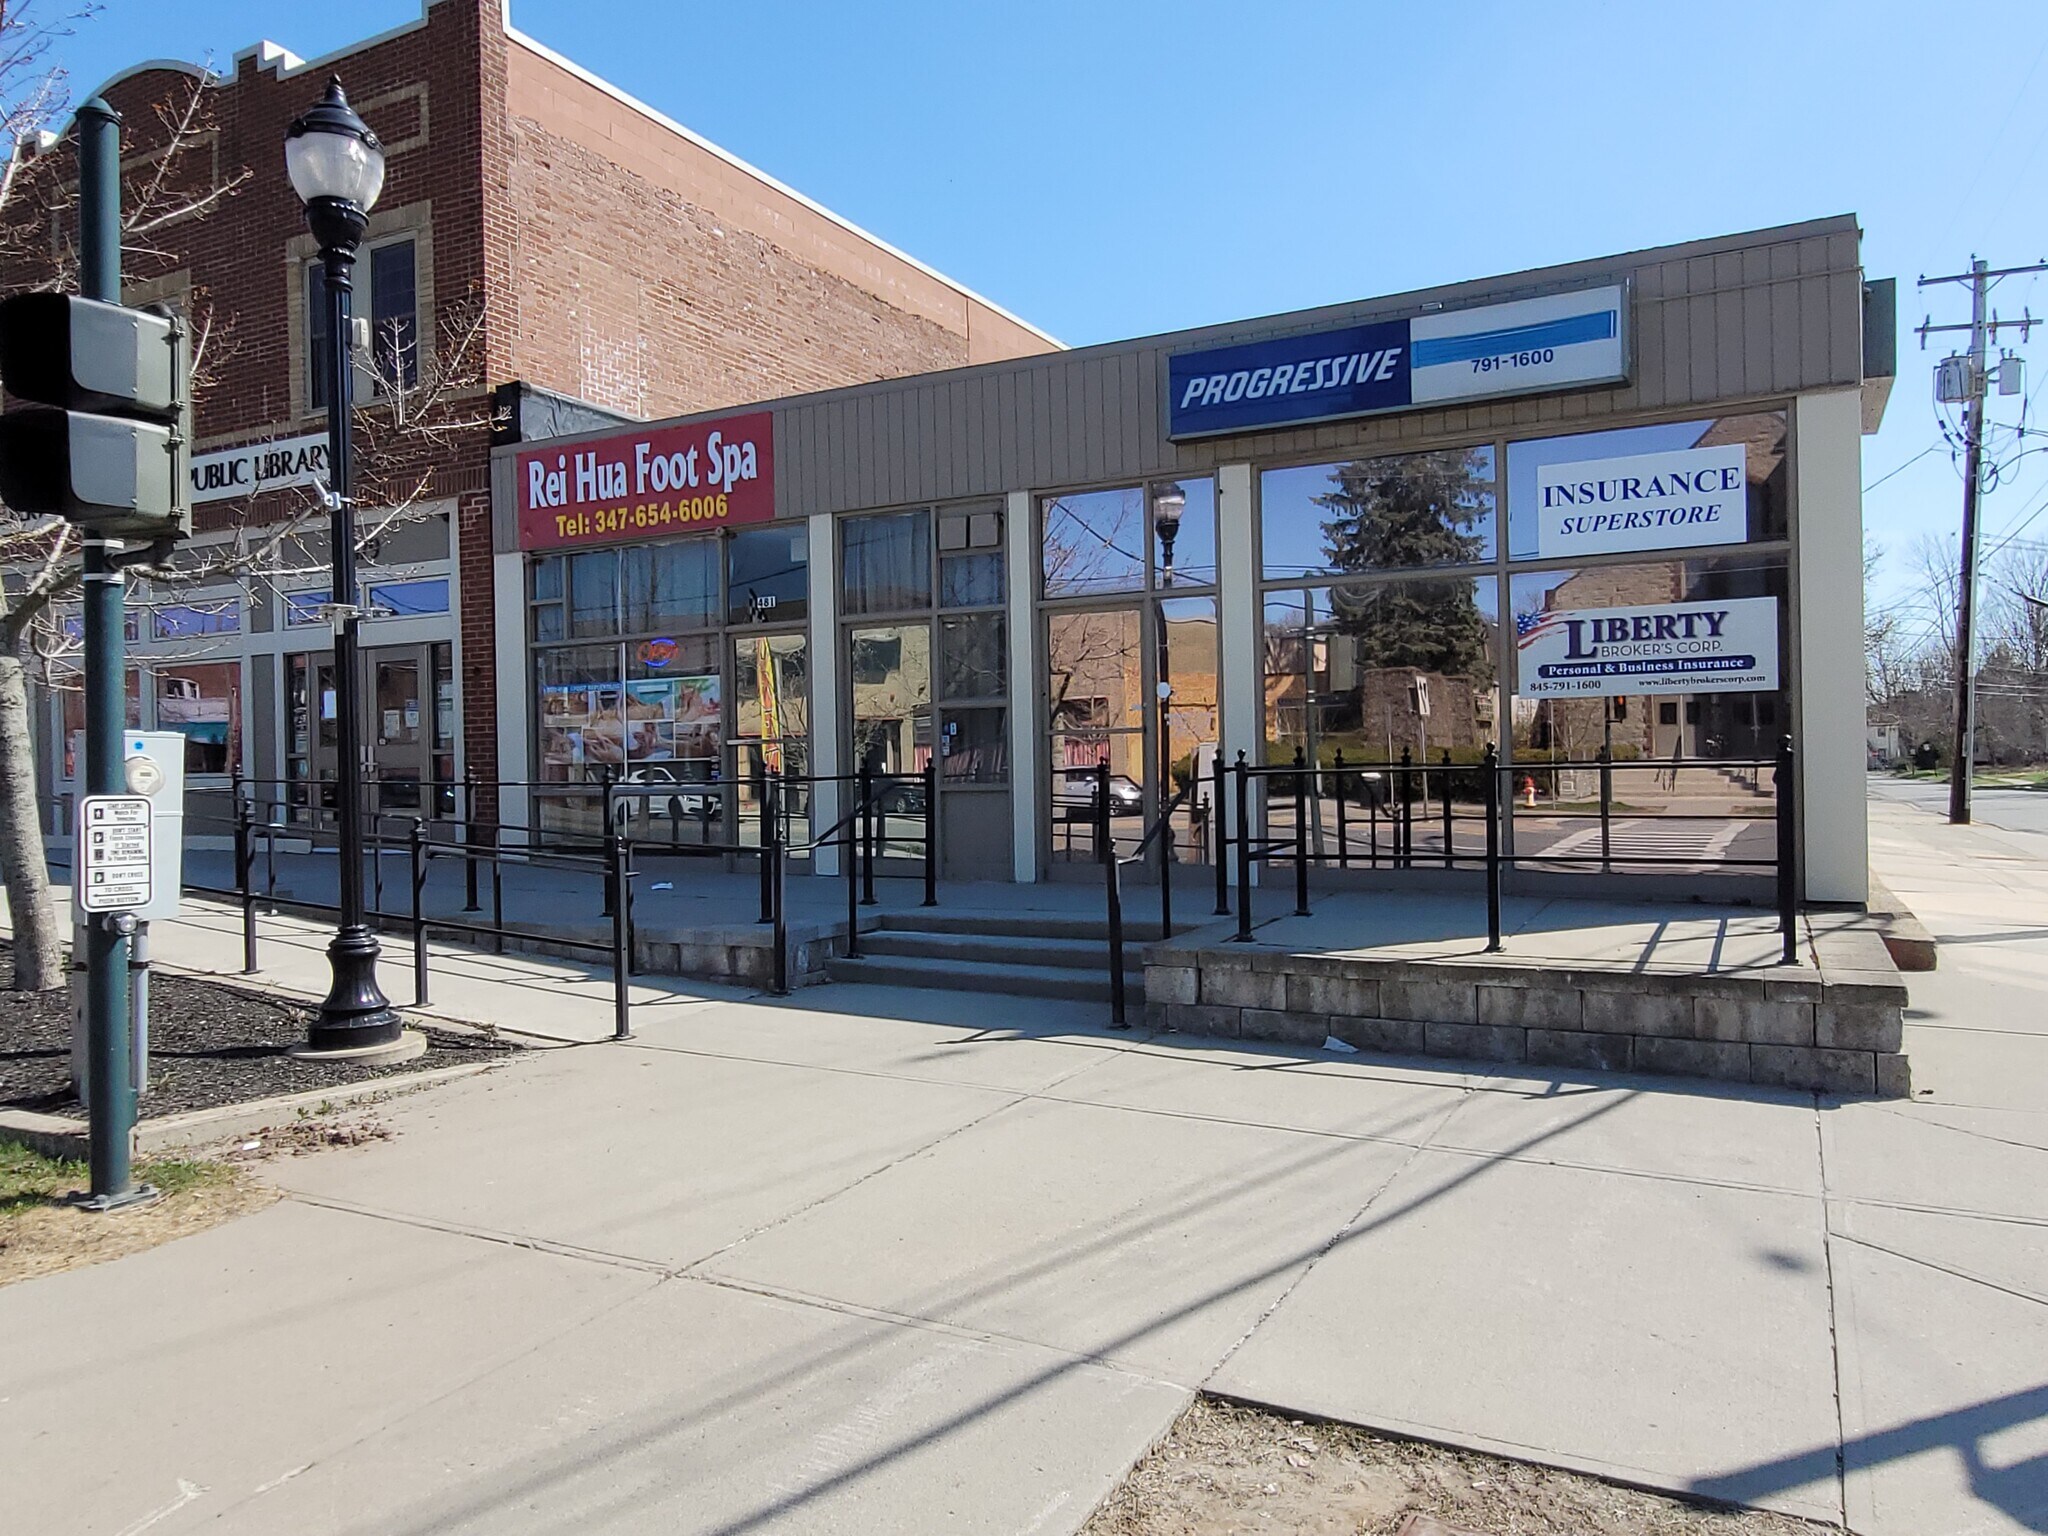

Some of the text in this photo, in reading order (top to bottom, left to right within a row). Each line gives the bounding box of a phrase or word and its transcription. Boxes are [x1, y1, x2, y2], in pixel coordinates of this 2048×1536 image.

[1471, 348, 1554, 373] 791-1600
[1180, 347, 1402, 409] PROGRESSIVE
[528, 431, 757, 509] Rei Hua Foot Spa
[1543, 467, 1741, 507] INSURANCE
[556, 493, 728, 538] Tel: 347-654-6006
[1560, 504, 1722, 535] SUPERSTORE
[1564, 610, 1729, 660] LIBERTY
[1601, 640, 1723, 658] BROKER'S CORP.
[1548, 658, 1745, 676] Personal & Business Insurance
[1638, 676, 1766, 687] www.libertybrokerscorp.com
[1530, 680, 1602, 692] 845-791-1600
